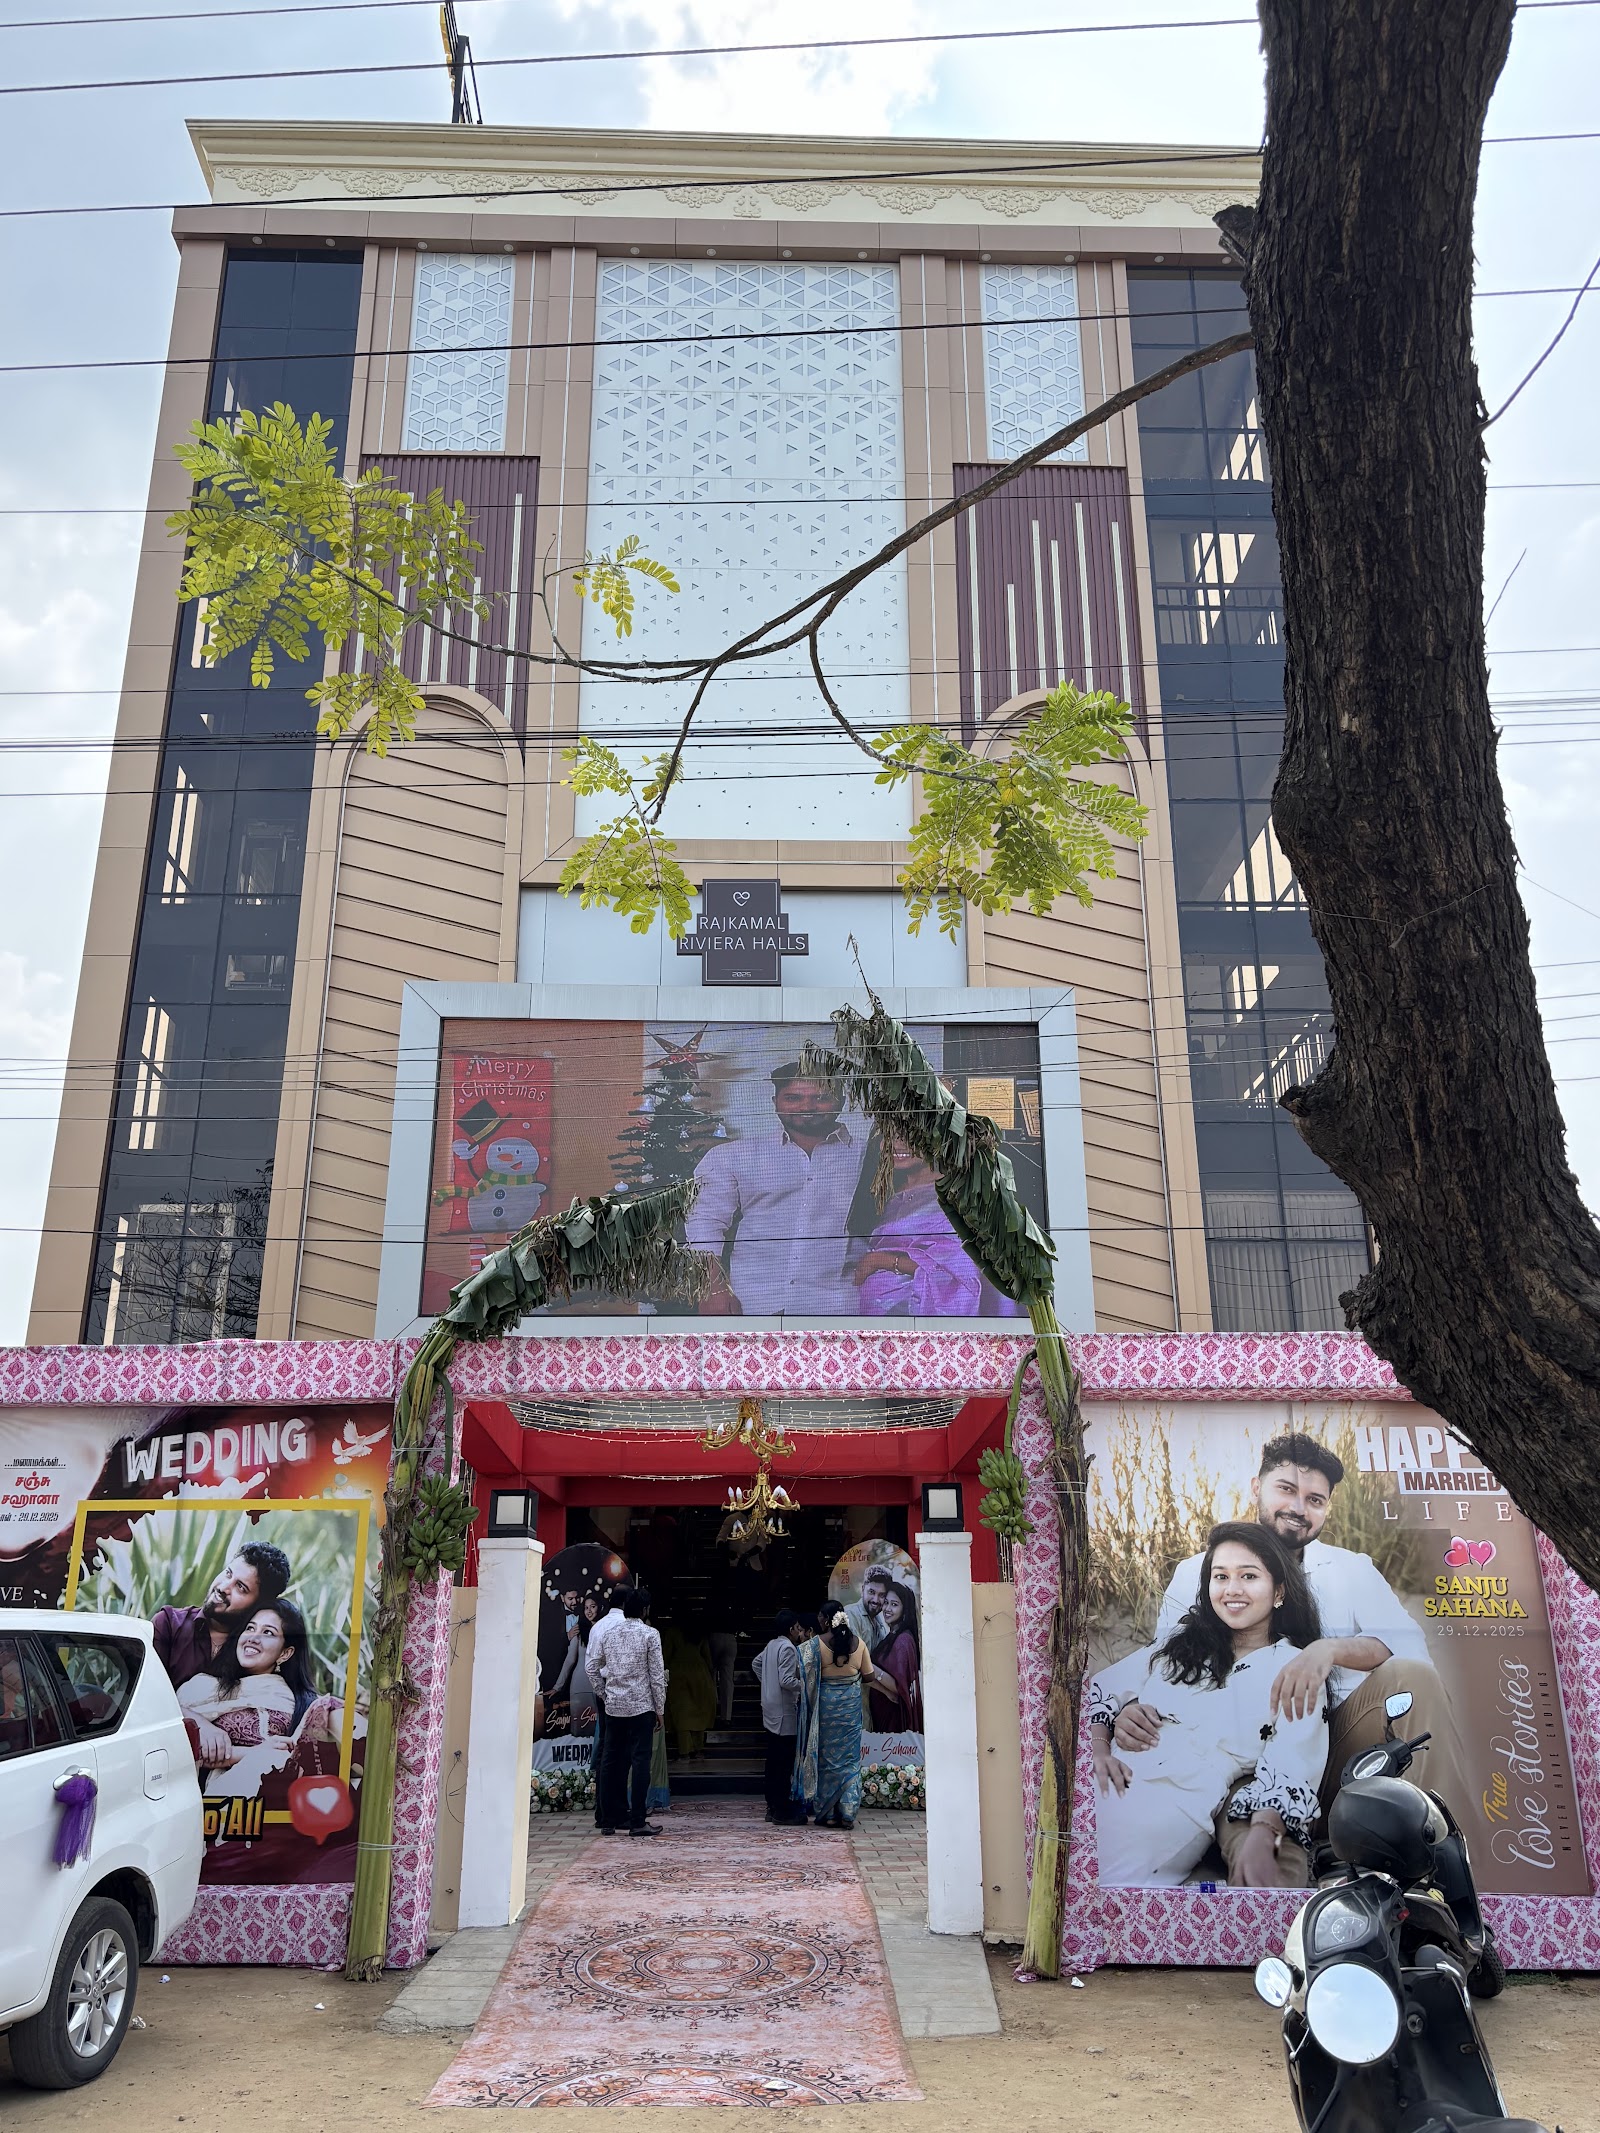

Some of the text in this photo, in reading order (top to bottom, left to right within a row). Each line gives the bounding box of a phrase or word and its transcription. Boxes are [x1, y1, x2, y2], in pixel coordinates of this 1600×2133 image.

[699, 916, 786, 933] RAJKAMAL
[679, 936, 806, 951] RIVIERA HALLS
[466, 1055, 535, 1079] Merry
[461, 1081, 547, 1102] Christmas
[125, 1418, 307, 1483] WEDDING
[1354, 1426, 1487, 1473] HAPP
[15, 1471, 51, 1491] சஞ்சு
[1403, 1472, 1502, 1492] MARRIED
[1, 1494, 60, 1509] சஹானா
[1381, 1501, 1513, 1522] LIFE
[18, 1512, 59, 1522] 29.12.2025
[1434, 1575, 1509, 1599] SANJU
[1424, 1597, 1529, 1619] SAHANA
[1437, 1625, 1525, 1637] 29.12.2025
[1490, 1653, 1545, 1785] stories
[1482, 1771, 1509, 1823] True
[226, 1796, 264, 1836] All
